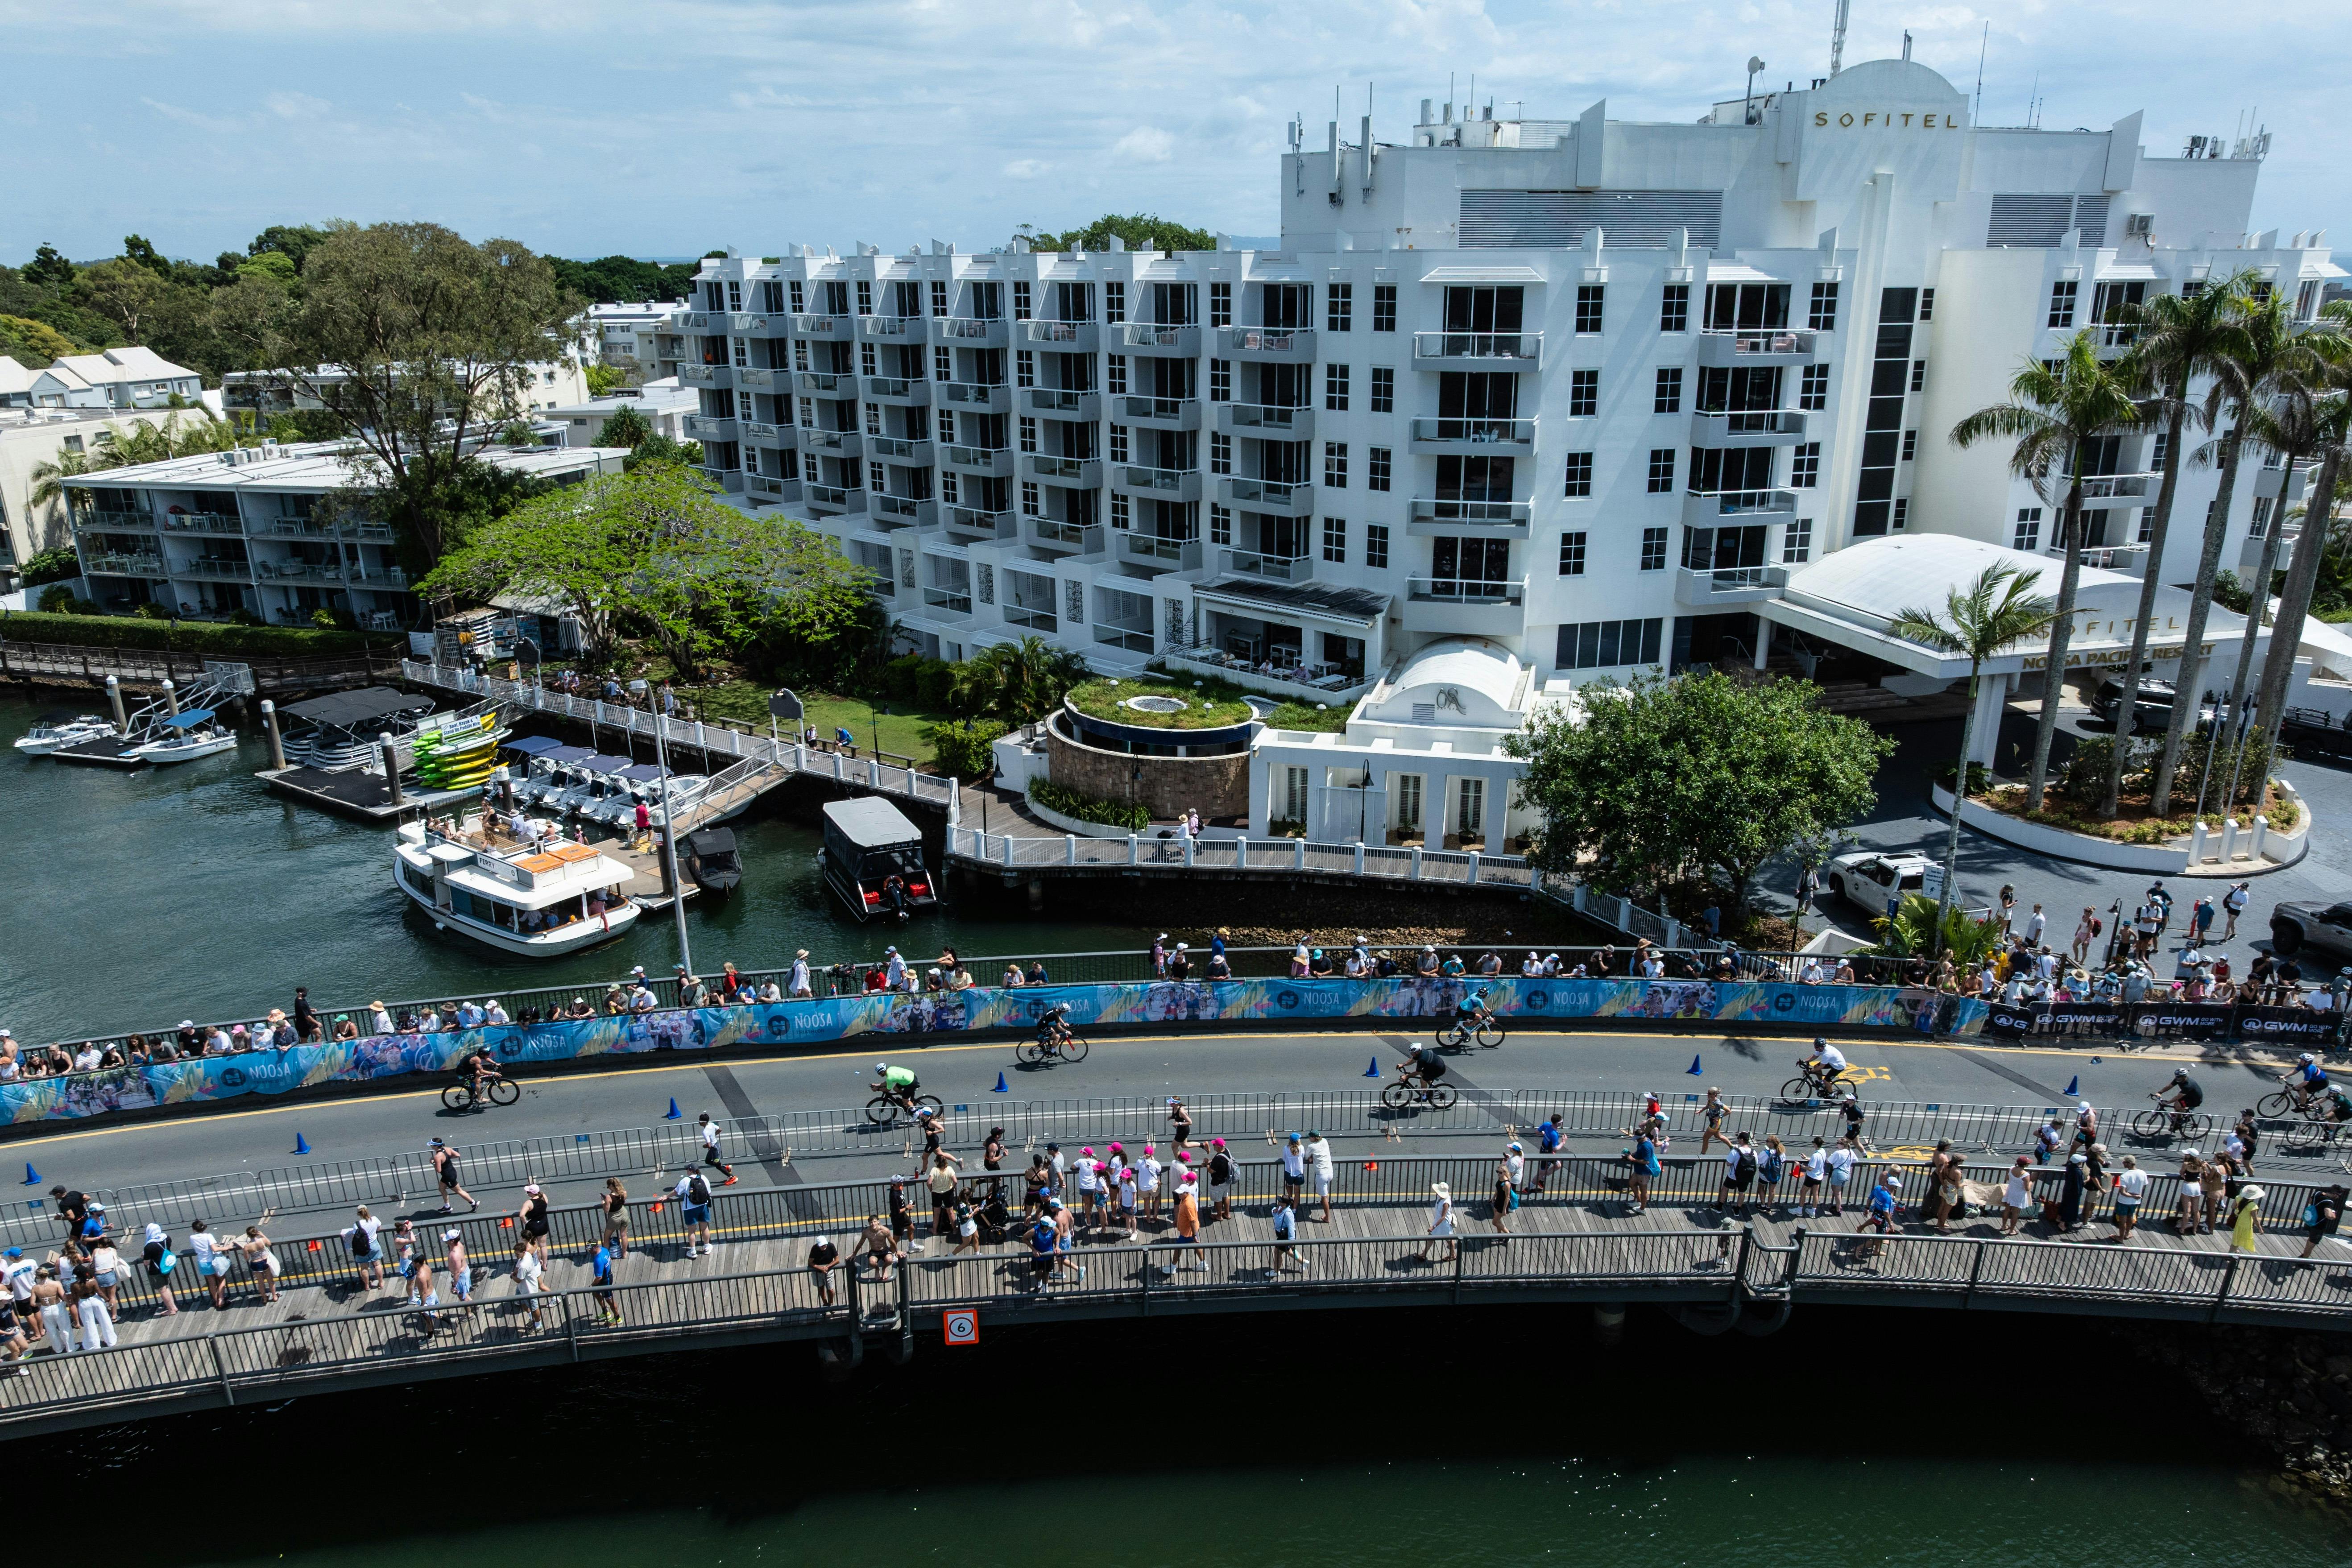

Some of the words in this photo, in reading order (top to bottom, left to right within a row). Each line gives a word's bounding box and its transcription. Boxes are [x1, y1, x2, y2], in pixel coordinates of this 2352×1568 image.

[1815, 112, 1958, 128] SOFITEL
[2022, 653, 2082, 669] NOSA
[2086, 648, 2149, 665] PACIFC
[2153, 643, 2216, 659] RESRT
[479, 857, 495, 869] FERRY
[1304, 992, 1339, 1005] NOOSA
[1553, 992, 1589, 1005] NOOSA
[1801, 995, 1837, 1009] NOOSA
[795, 1013, 833, 1029] NOOSA
[2056, 1015, 2095, 1023] GWM
[2159, 1017, 2200, 1025] GWM
[2264, 1021, 2307, 1032] GWM
[528, 1034, 566, 1050] NOOSA
[249, 1062, 291, 1080] NOOSA
[957, 1322, 965, 1332] 6
